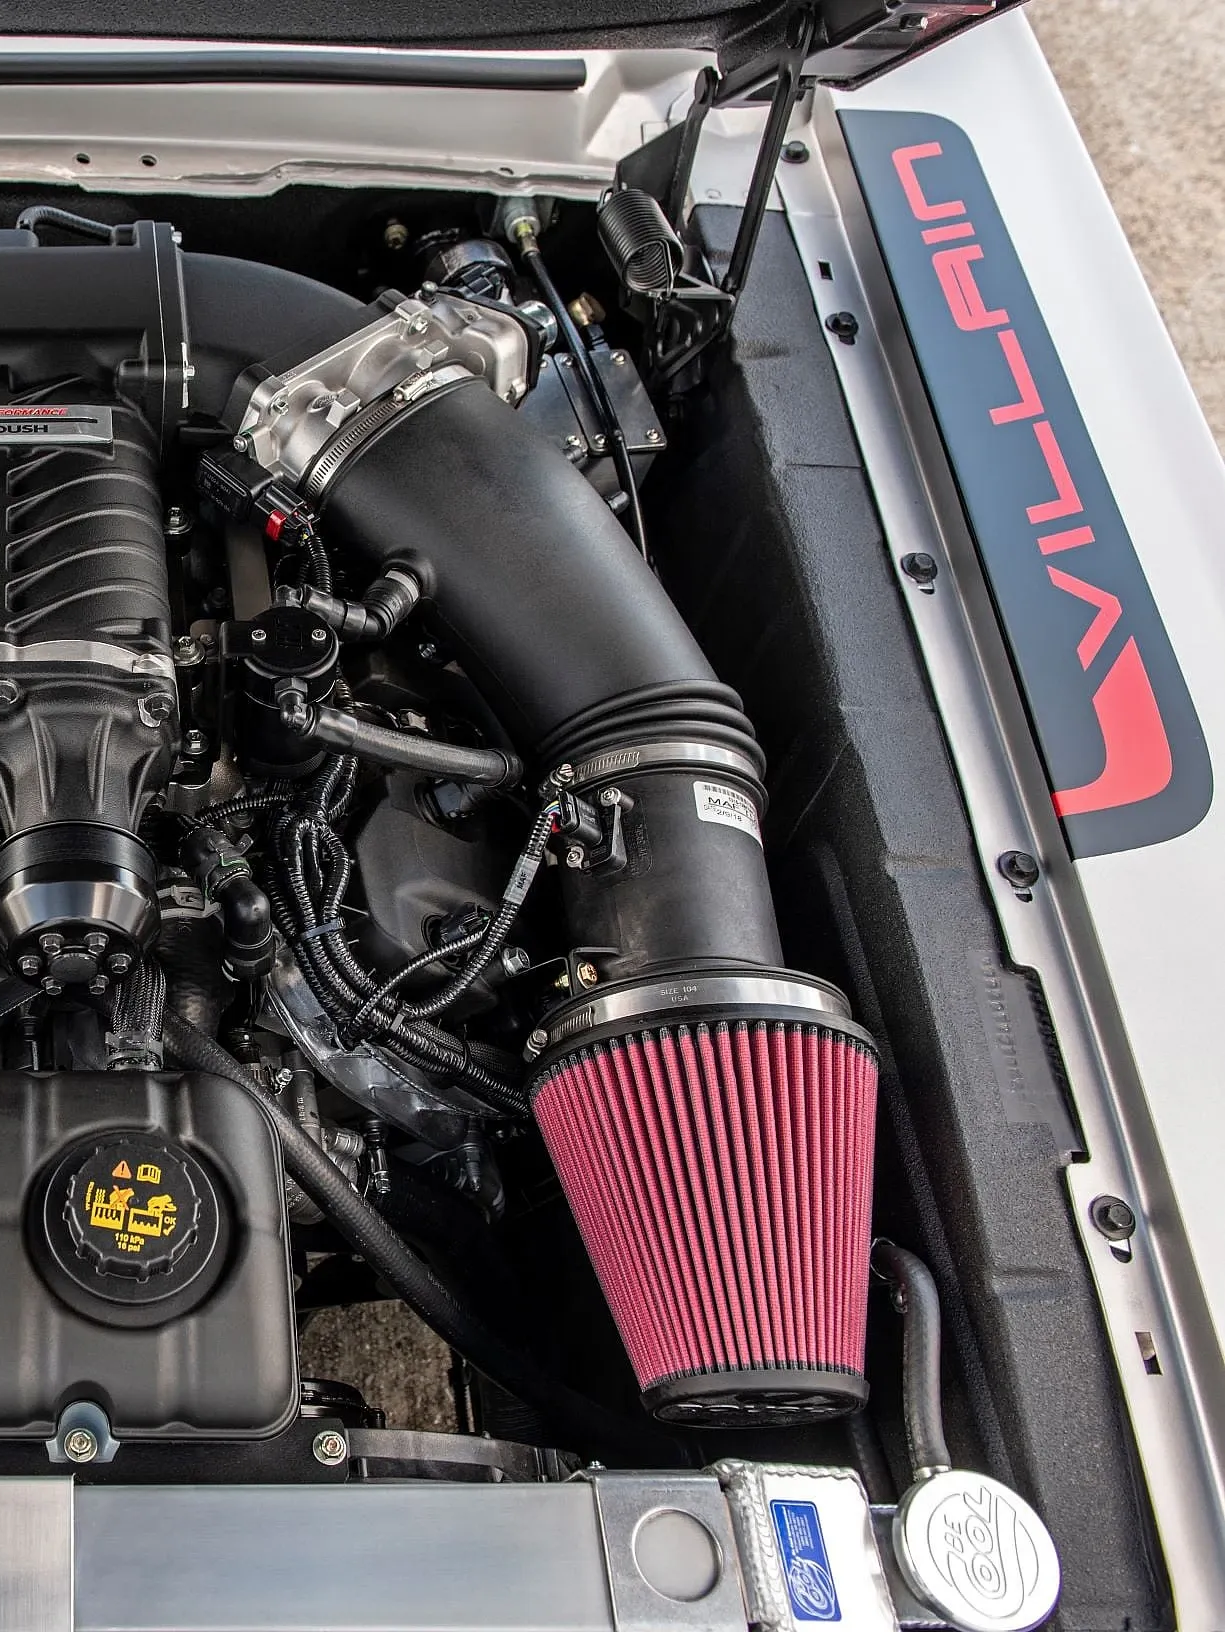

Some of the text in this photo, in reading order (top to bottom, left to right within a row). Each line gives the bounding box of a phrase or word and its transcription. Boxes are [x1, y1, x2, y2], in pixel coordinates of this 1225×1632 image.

[708, 796, 739, 810] MAF
[660, 988, 679, 996] SIZE
[671, 995, 688, 1003] USA
[164, 1216, 176, 1225] OK
[115, 1232, 145, 1246] 110 kPa
